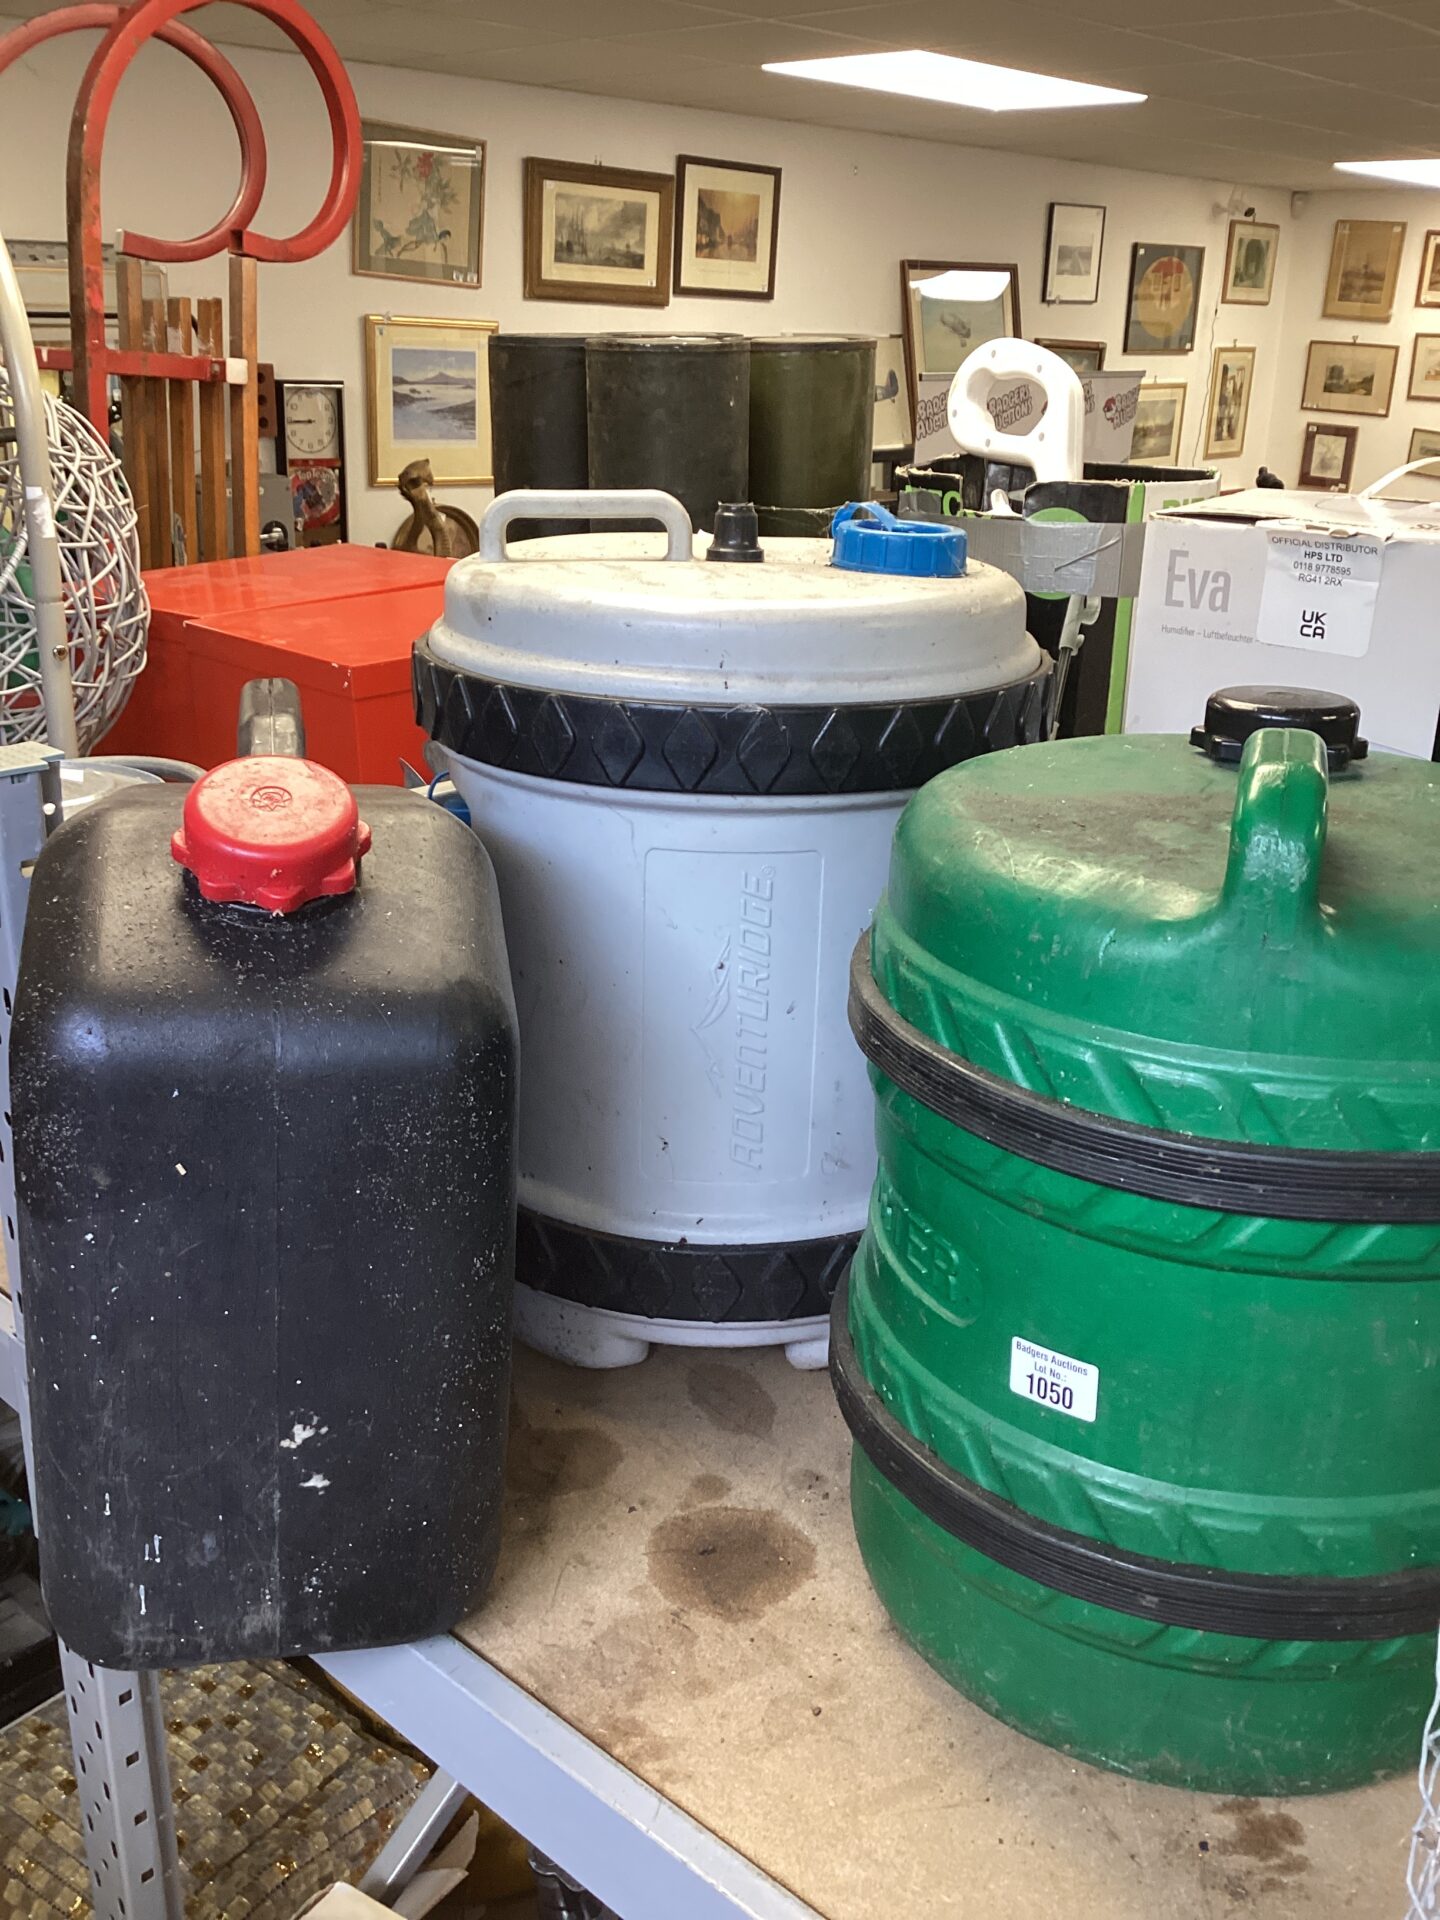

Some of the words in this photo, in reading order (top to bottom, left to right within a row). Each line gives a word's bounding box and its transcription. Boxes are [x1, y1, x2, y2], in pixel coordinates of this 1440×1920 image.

[917, 389, 951, 421] BADG
[994, 396, 1033, 431] UCTIONS
[1271, 536, 1312, 548] OFFICIAL
[1314, 540, 1378, 555] DISTRIBUTOR
[1303, 550, 1323, 561] HPS
[1325, 552, 1343, 563] LTD
[1293, 560, 1313, 572] 0118
[1315, 563, 1352, 576] 9778595
[1164, 549, 1232, 613] Eva
[1298, 573, 1322, 584] RG41
[1324, 575, 1343, 587] 2RX
[1302, 609, 1327, 626] UK
[1161, 623, 1196, 637] Humidifier
[1203, 628, 1254, 644] Luftbefeuchter
[1299, 623, 1325, 640] CA
[1016, 1340, 1049, 1362] Badgers
[1051, 1355, 1089, 1377] Auctions
[1034, 1361, 1047, 1375] Lot
[1026, 1373, 1074, 1410] 1050
